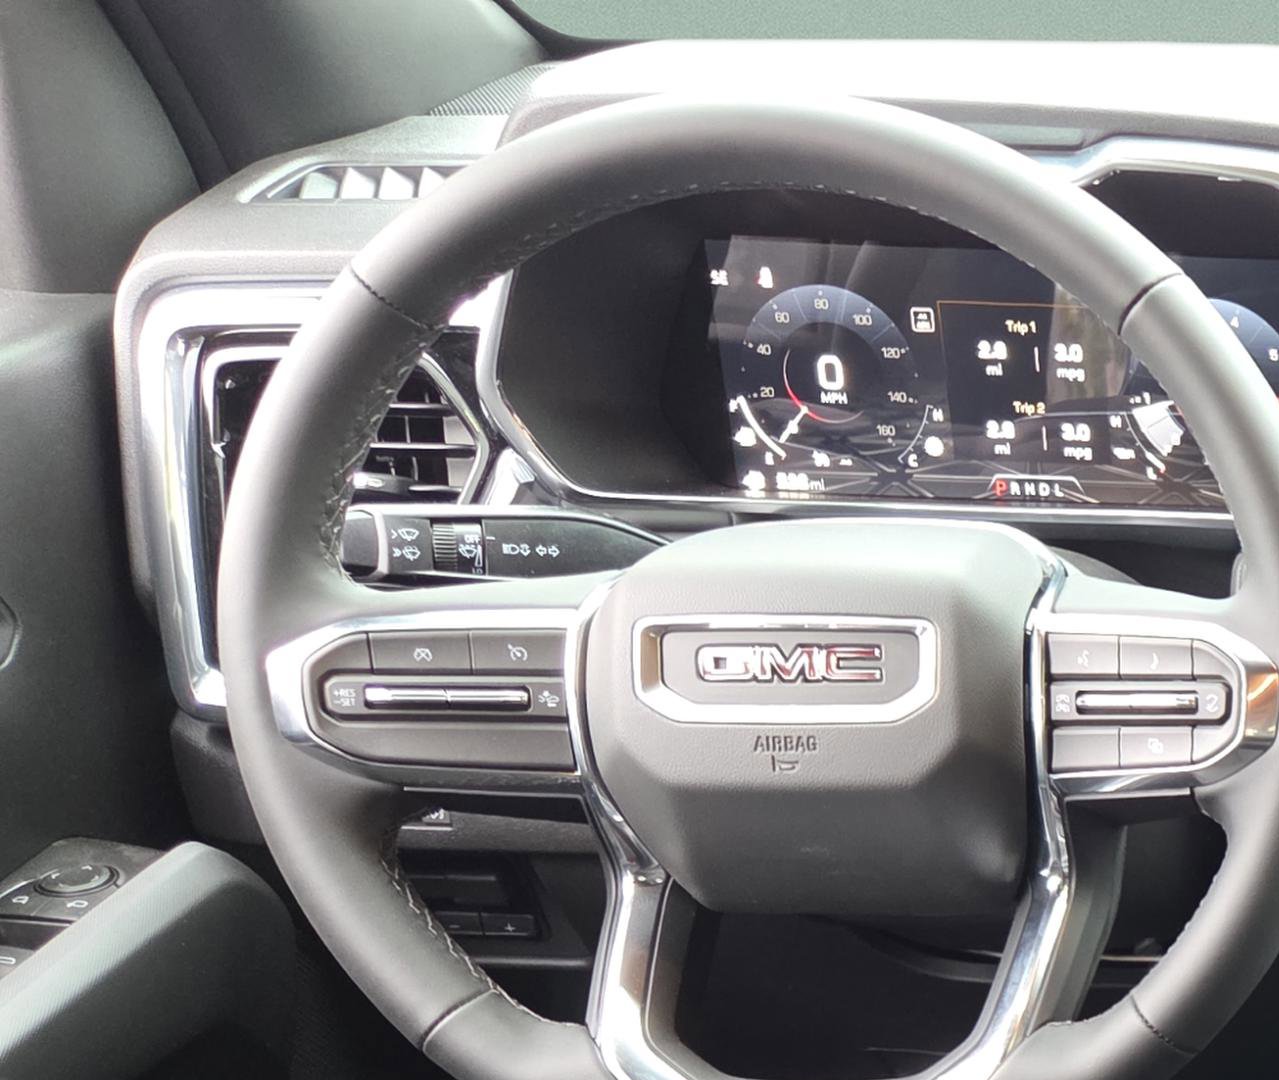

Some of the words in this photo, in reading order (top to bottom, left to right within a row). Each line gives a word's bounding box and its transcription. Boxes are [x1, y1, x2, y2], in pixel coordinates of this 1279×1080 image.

[814, 299, 829, 310] 80
[775, 312, 790, 323] 60
[852, 314, 873, 326] 100
[1005, 319, 1028, 336] Trip
[1029, 321, 1037, 333] 1
[757, 344, 772, 355] 40
[881, 347, 900, 359] 120
[817, 354, 845, 390] 0
[985, 362, 1003, 376] mi
[1056, 367, 1085, 382] mpg
[760, 387, 775, 398] 20
[820, 392, 848, 404] MPH
[888, 391, 907, 403] 140
[1013, 401, 1035, 416] Trip
[1037, 402, 1046, 414] 2
[876, 425, 895, 436] 160
[994, 442, 1011, 455] mi
[1063, 447, 1092, 461] mpg
[464, 534, 480, 544] OFF
[696, 643, 883, 683] GMC
[753, 735, 818, 752] AIRBAG
